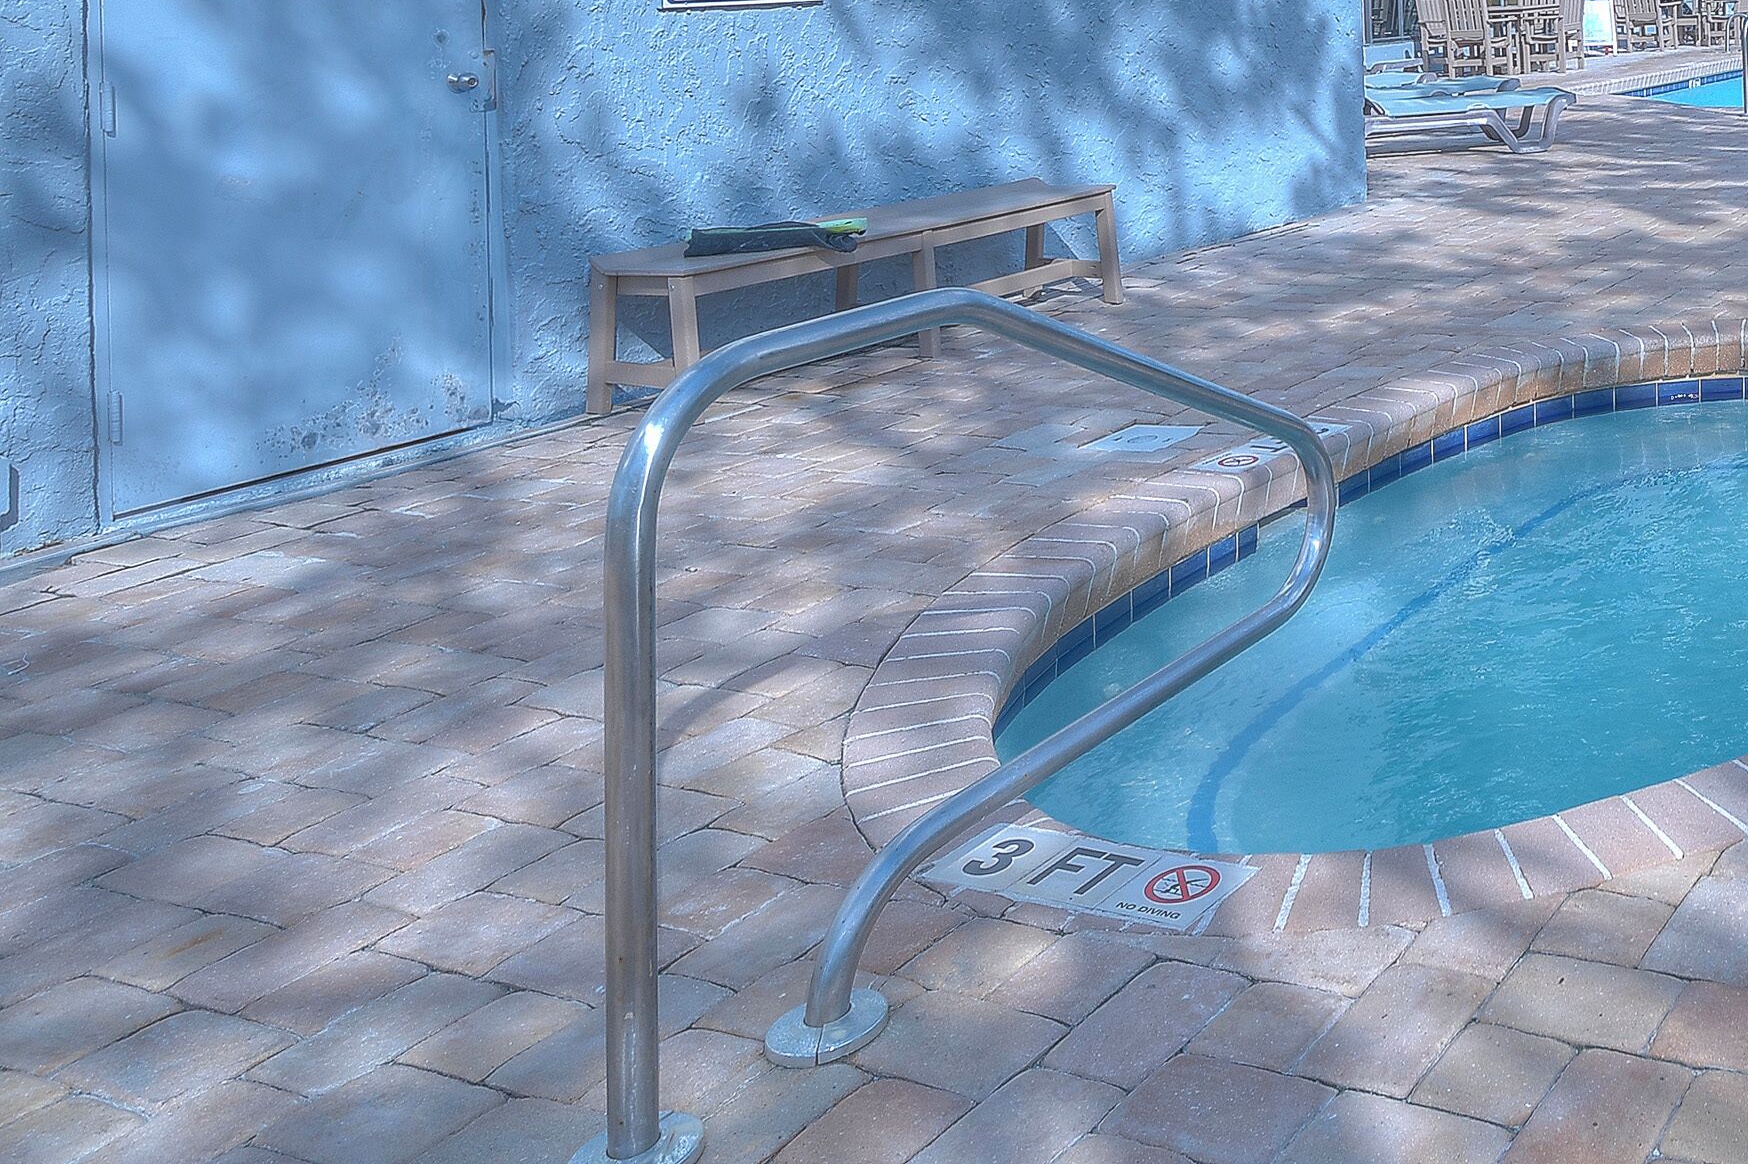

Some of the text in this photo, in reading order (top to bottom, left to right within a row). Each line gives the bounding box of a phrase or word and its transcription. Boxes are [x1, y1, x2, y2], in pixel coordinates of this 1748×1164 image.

[962, 839, 1145, 896] 3 FT
[1115, 901, 1182, 920] NO DIVING
